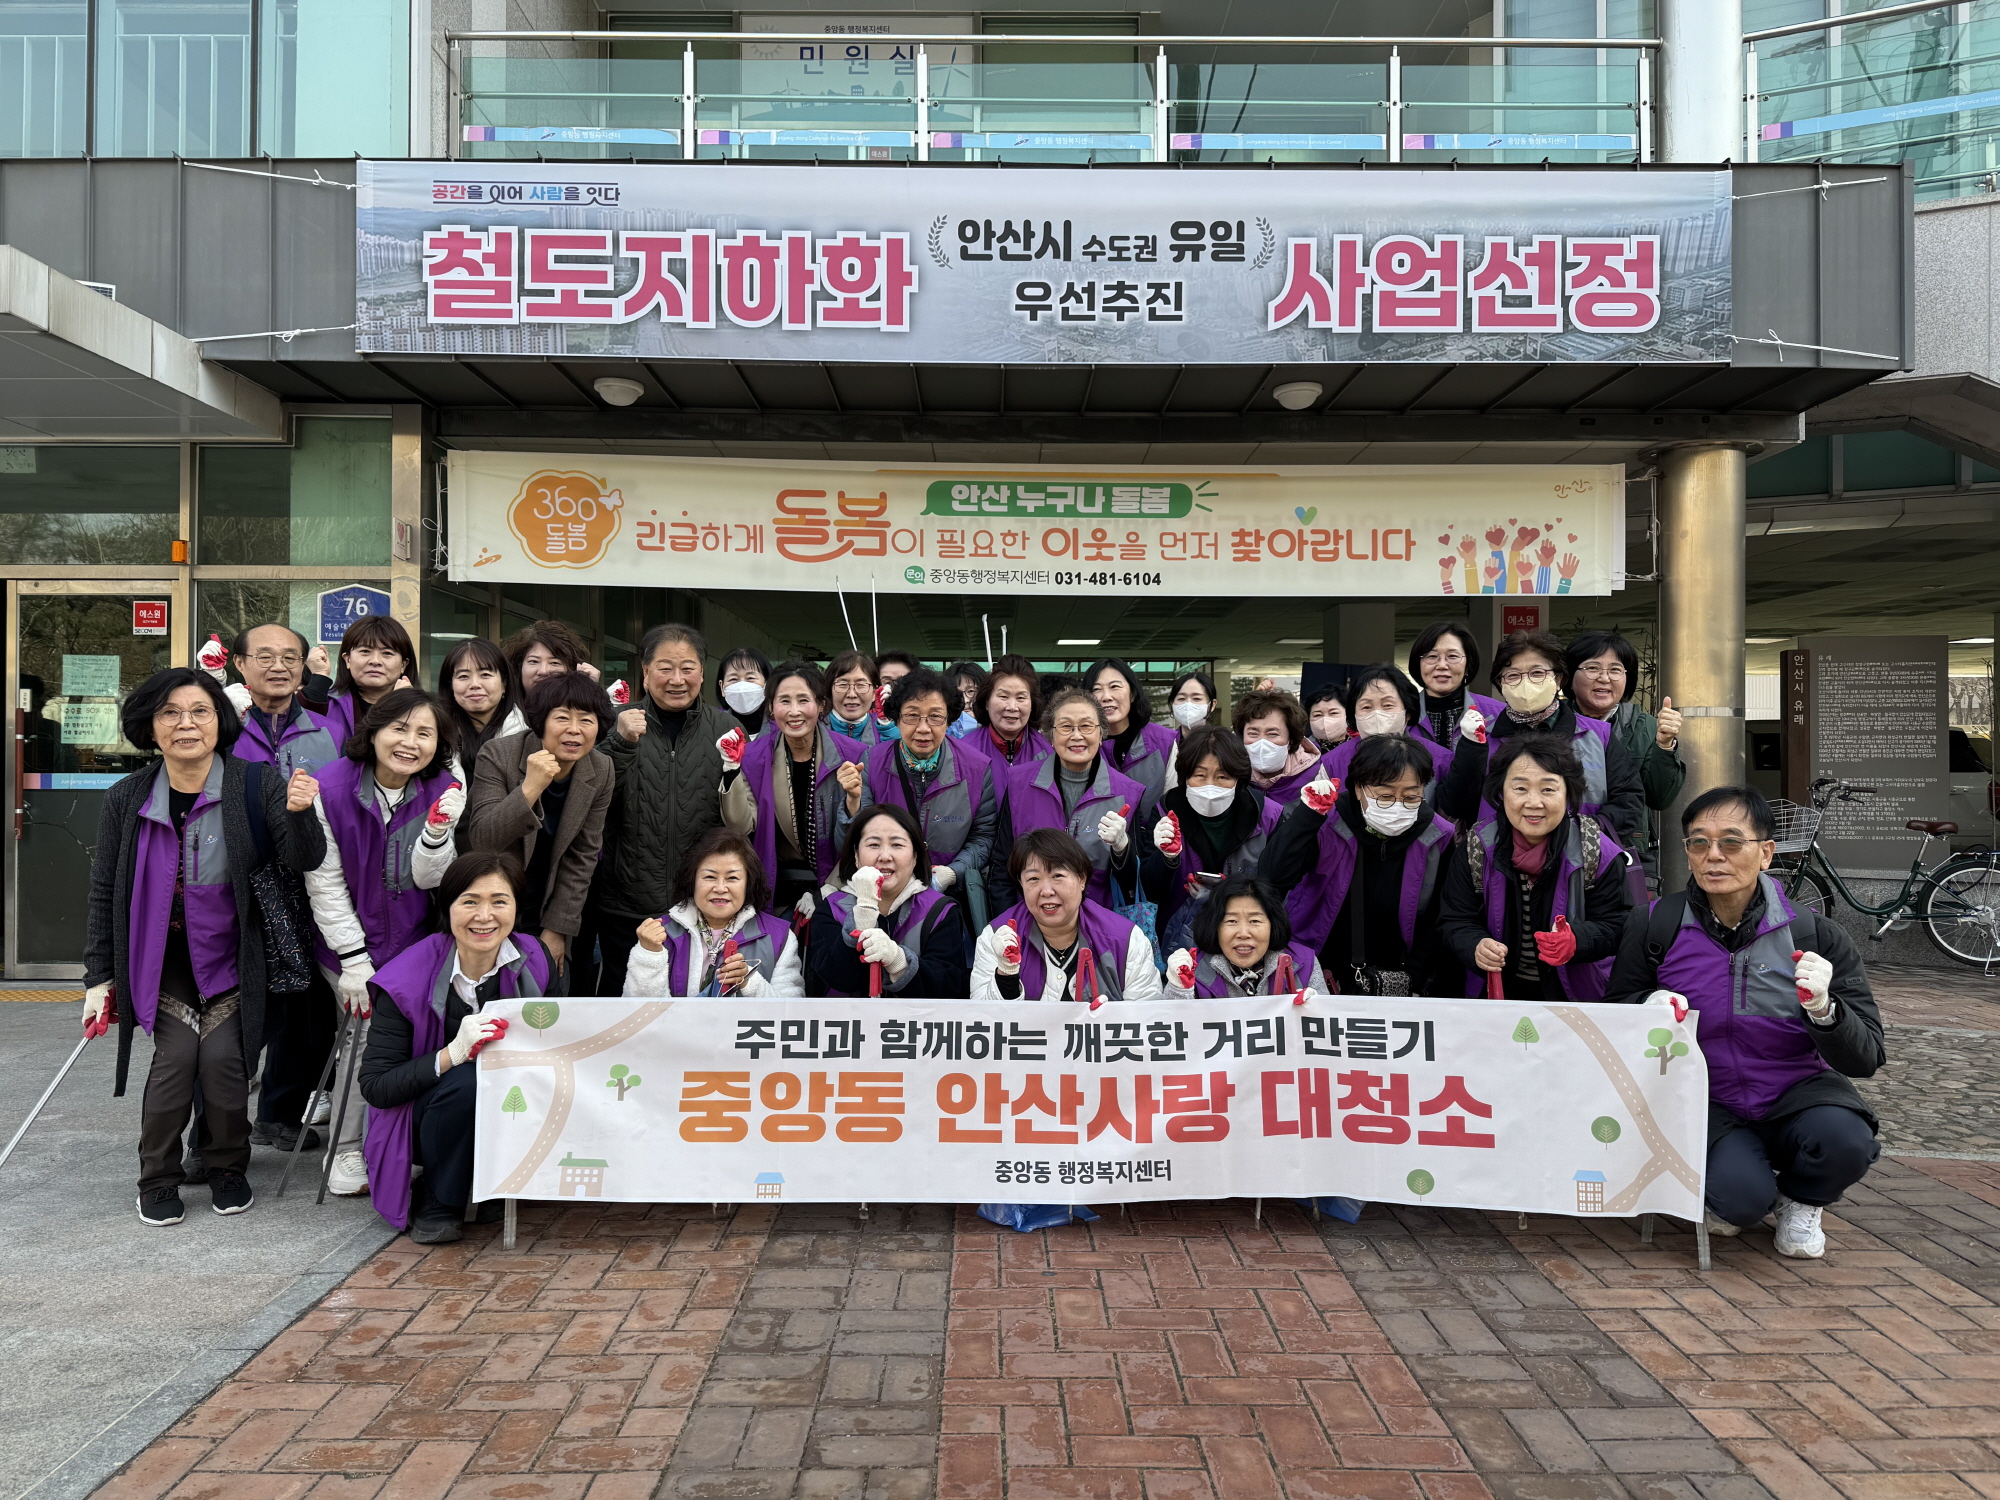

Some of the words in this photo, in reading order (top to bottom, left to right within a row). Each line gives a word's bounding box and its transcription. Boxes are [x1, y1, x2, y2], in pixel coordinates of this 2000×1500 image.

[824, 25, 845, 33] 중앙동
[848, 25, 890, 34] 행정복지센터
[1923, 102, 1958, 111] Community
[1958, 98, 1980, 108] Service
[1034, 136, 1053, 145] 중앙동
[1507, 137, 1526, 145] 중앙동
[432, 184, 483, 201] 공간을
[490, 184, 523, 201] 이어
[529, 186, 580, 201] 사람을
[587, 186, 620, 202] 잇다
[957, 218, 1072, 262] 안산시
[1082, 235, 1158, 263] 수도권
[1169, 220, 1246, 263] 유일
[426, 226, 915, 329] 철도지하화
[1270, 235, 1660, 331] 사업선정
[1014, 280, 1184, 322] 우선추진
[533, 487, 597, 522] 360
[950, 483, 1010, 513] 안산
[1016, 485, 1106, 514] 누구나
[1110, 485, 1171, 514] 돌봄
[635, 512, 766, 555] 긴급하게
[772, 489, 924, 563] 돌봄이
[936, 526, 1030, 560] 필요한
[1041, 527, 1148, 563] 이웃을
[1159, 529, 1220, 562] 먼저
[1231, 526, 1416, 563] 찾아갑니다
[545, 524, 588, 555] 돌봄
[906, 569, 924, 581] 문의
[929, 567, 1051, 587] 중앙동행정복지센터
[1054, 570, 1162, 587] 031-481-6104
[139, 609, 161, 619] 에스원
[343, 597, 368, 616] 76
[324, 622, 352, 632] 예술대
[1507, 615, 1535, 626] 에스원
[1793, 654, 1805, 694] 안산시
[1793, 700, 1805, 726] 유래
[735, 1019, 866, 1060] 주민과
[880, 1019, 1047, 1062] 함께하는
[1063, 1020, 1188, 1063] 깨끗한
[1202, 1016, 1286, 1059] 거리
[1301, 1016, 1436, 1063] 만들기
[678, 1071, 906, 1144] 중앙동
[936, 1070, 1236, 1145] 안산사랑
[1260, 1067, 1496, 1150] 대청소
[994, 1160, 1052, 1185] 중앙동
[1057, 1159, 1172, 1185] 행정복지센터
